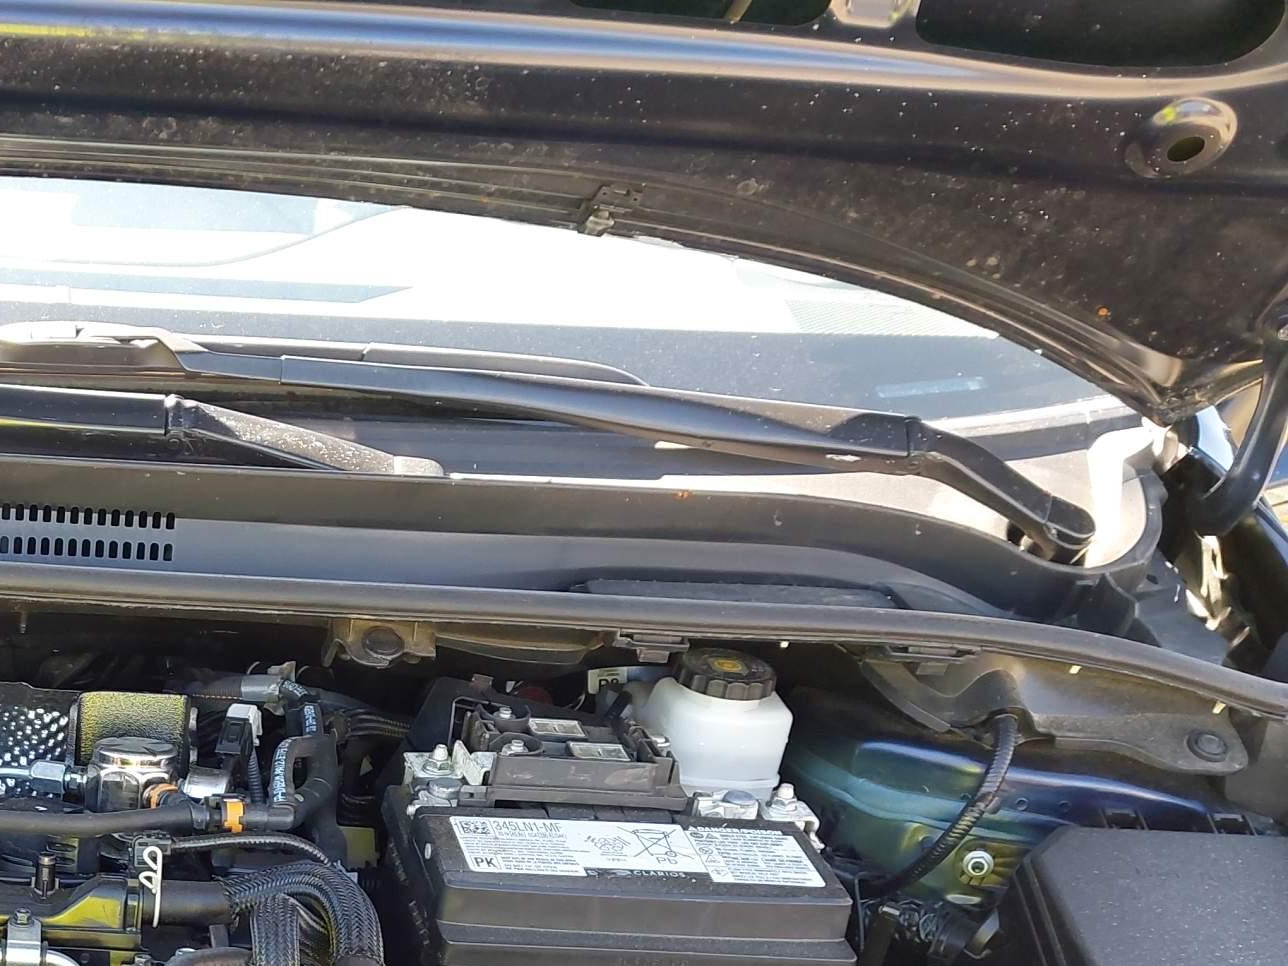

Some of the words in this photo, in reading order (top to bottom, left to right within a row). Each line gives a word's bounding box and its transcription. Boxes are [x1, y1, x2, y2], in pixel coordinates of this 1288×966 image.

[474, 856, 497, 868] PK
[656, 856, 678, 865] Pb
[633, 869, 686, 878] CLARIOS
